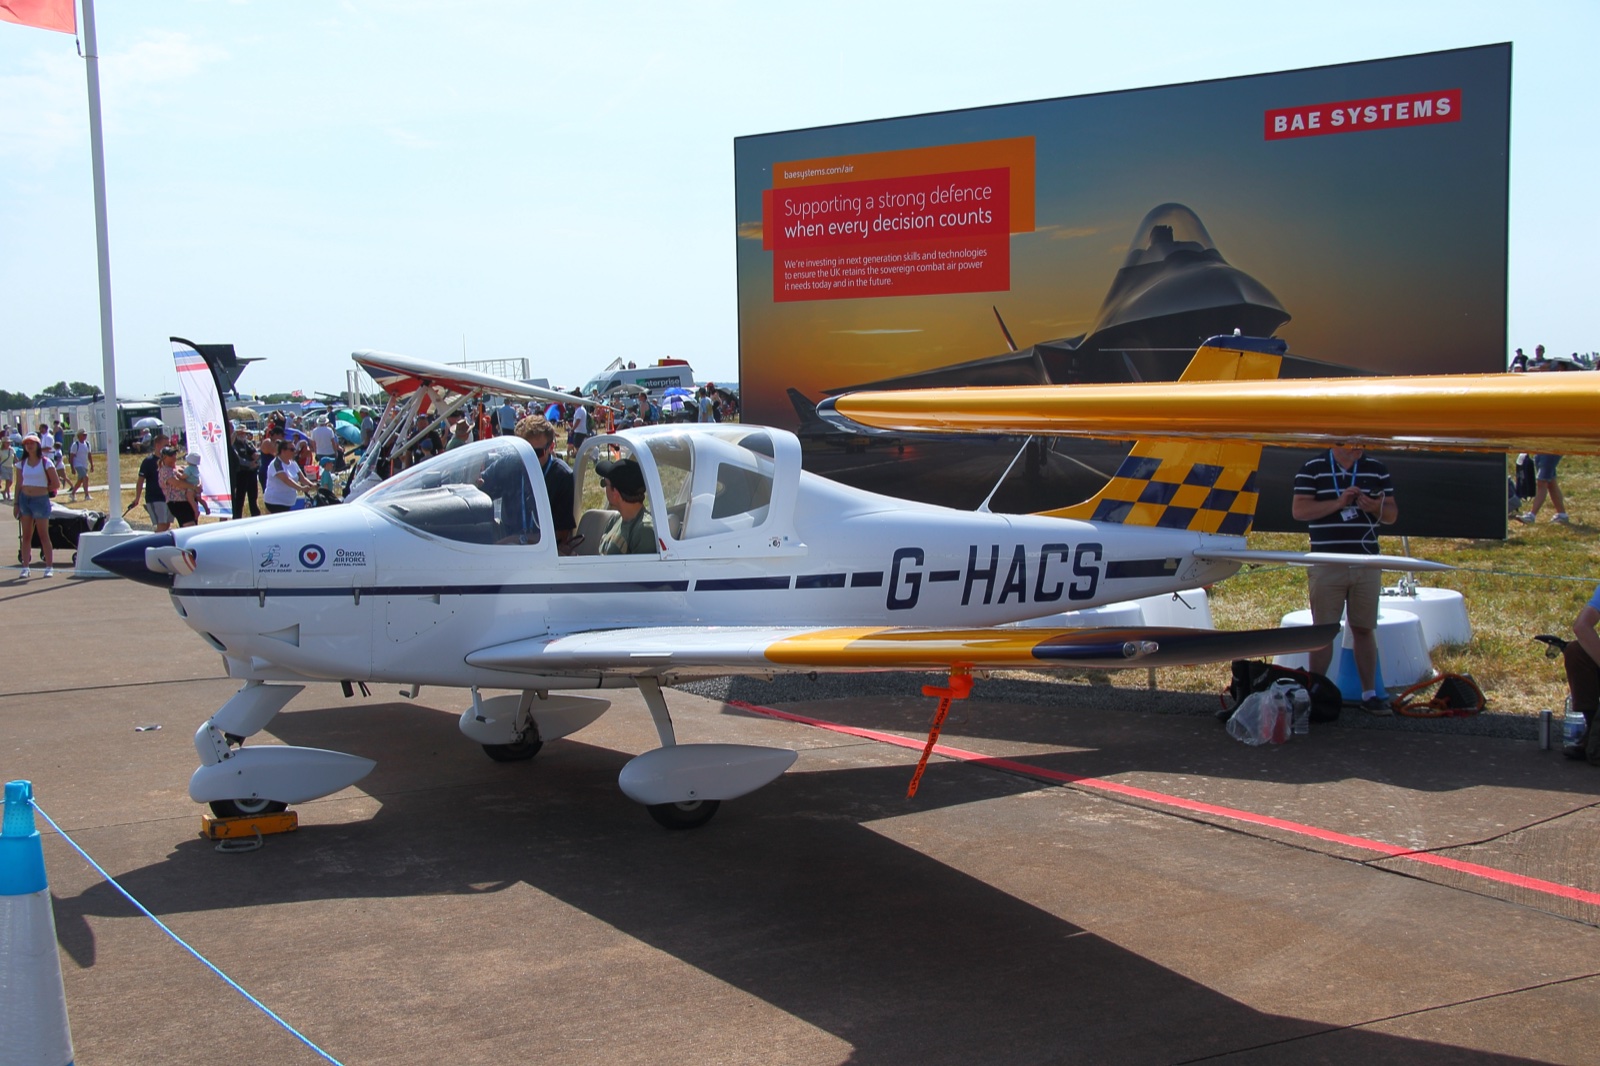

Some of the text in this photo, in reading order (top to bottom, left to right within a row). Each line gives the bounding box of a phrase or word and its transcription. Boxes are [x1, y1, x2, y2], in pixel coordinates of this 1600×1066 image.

[1274, 98, 1451, 132] BAE SYSTEMS
[784, 164, 854, 180] baesystems.com/air
[784, 184, 992, 220] Supporting a strong defence
[784, 207, 992, 239] when every decision counts
[784, 248, 987, 269] We're investing in next generation skills and technologies
[784, 261, 984, 280] to ensure the UK retains the sovereign combat air power
[784, 277, 894, 291] it needs today and in the future.
[886, 543, 1103, 610] G-HACS
[934, 697, 949, 730] REMOVE
[911, 763, 925, 790] FLIGHT
